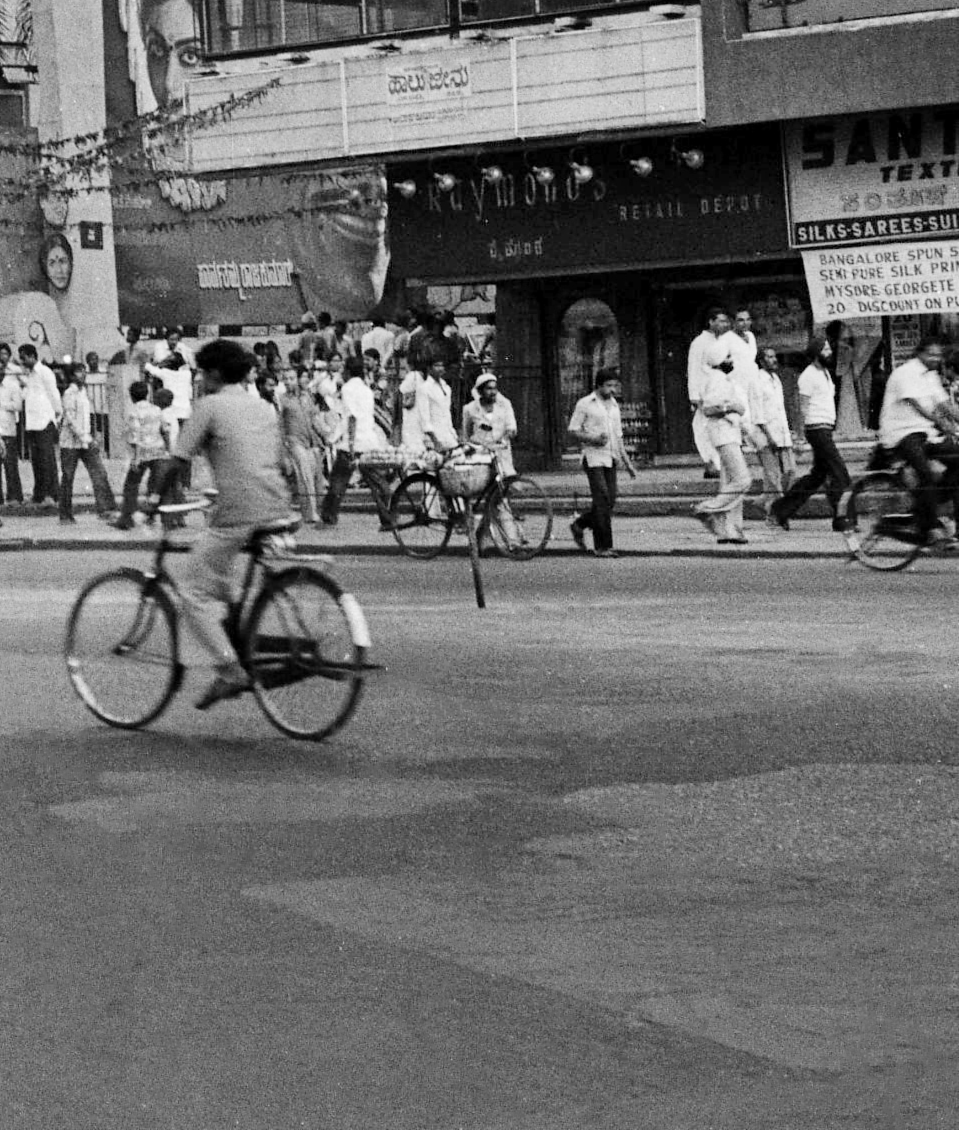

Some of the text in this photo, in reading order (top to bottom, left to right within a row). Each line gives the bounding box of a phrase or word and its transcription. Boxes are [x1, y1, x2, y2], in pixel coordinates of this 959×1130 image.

[802, 111, 959, 170] SANT
[618, 201, 684, 221] RETAIL
[700, 193, 762, 215] DEPOT
[819, 250, 900, 266] BANGALORE
[907, 247, 943, 261] SPUN
[851, 267, 885, 280] PURE
[891, 264, 923, 278] SILK
[825, 279, 955, 298] MYSORE GEORGETE
[827, 301, 846, 315] 20
[858, 298, 920, 313] DISCOUNT
[925, 297, 942, 310] ON
